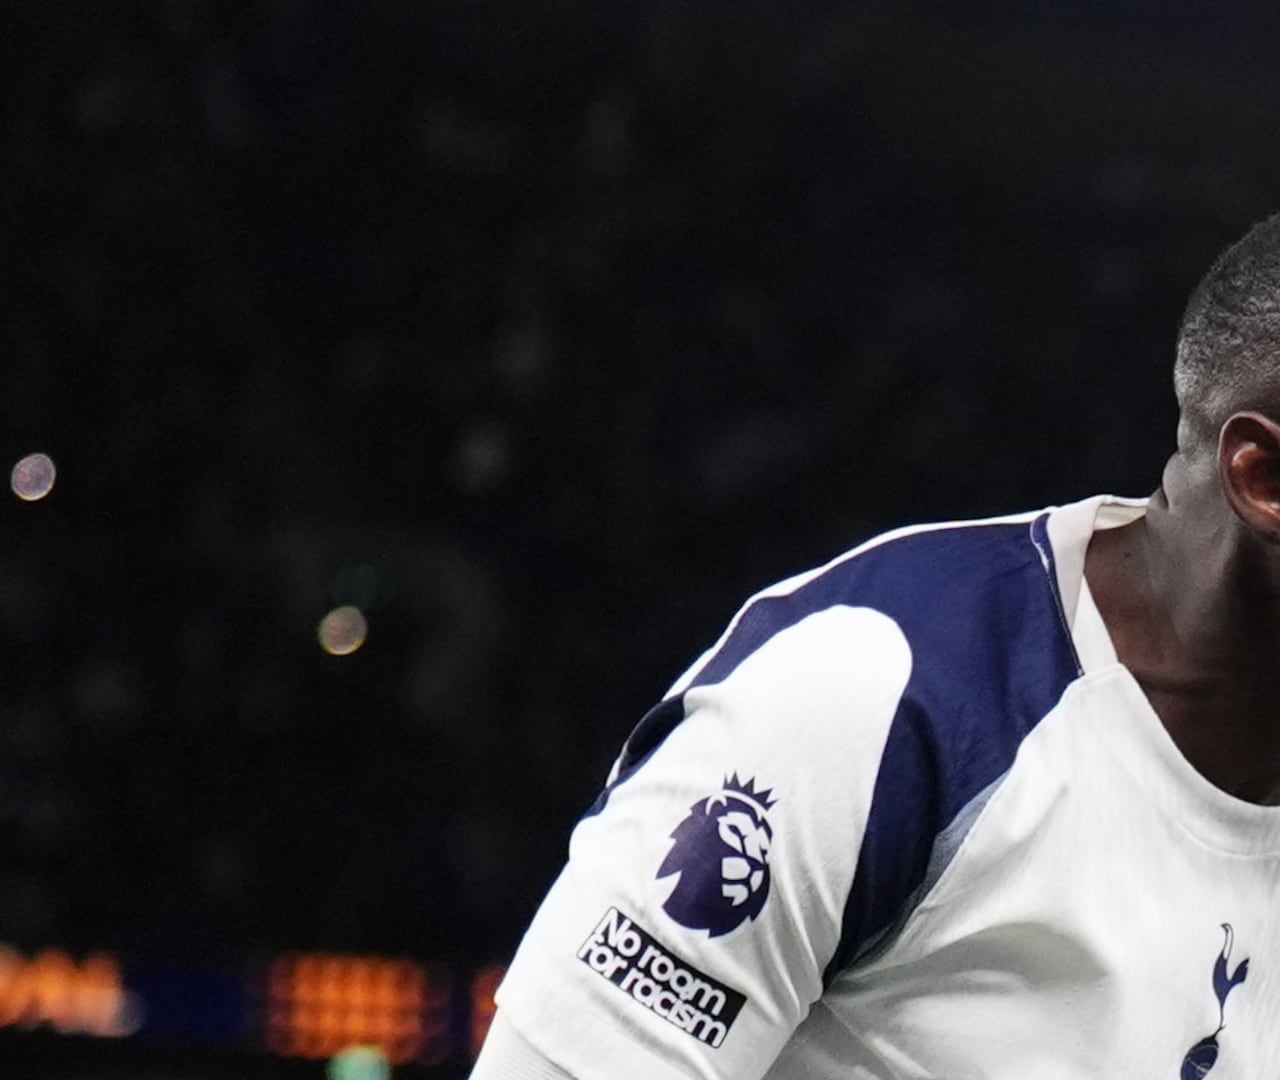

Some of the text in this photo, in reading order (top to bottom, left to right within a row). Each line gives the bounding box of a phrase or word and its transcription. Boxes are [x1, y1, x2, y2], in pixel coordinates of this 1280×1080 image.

[578, 936, 728, 1047] for racism
[598, 908, 727, 1016] No room
